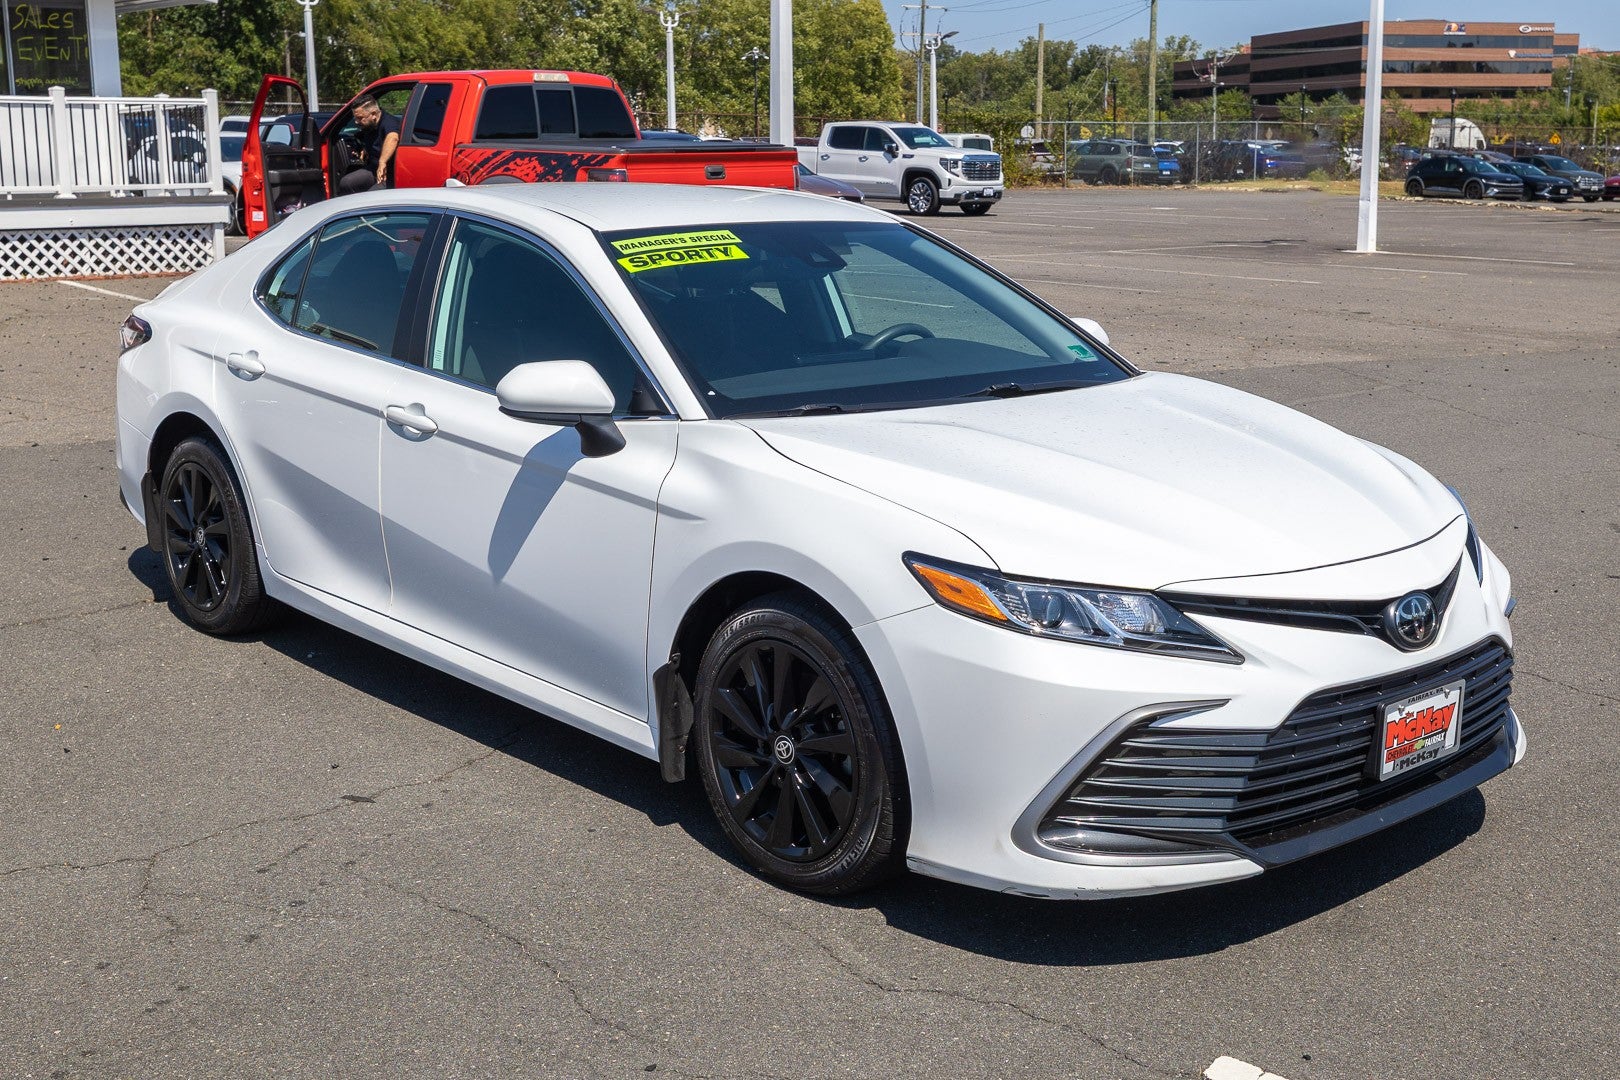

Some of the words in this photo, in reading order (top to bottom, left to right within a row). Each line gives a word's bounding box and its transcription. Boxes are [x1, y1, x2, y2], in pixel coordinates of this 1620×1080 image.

[618, 237, 687, 251] MANAGER'S
[688, 233, 736, 243] SPECIAL
[628, 246, 733, 268] SPORTY
[1385, 702, 1456, 749] McKay
[1399, 748, 1440, 770] McKay
